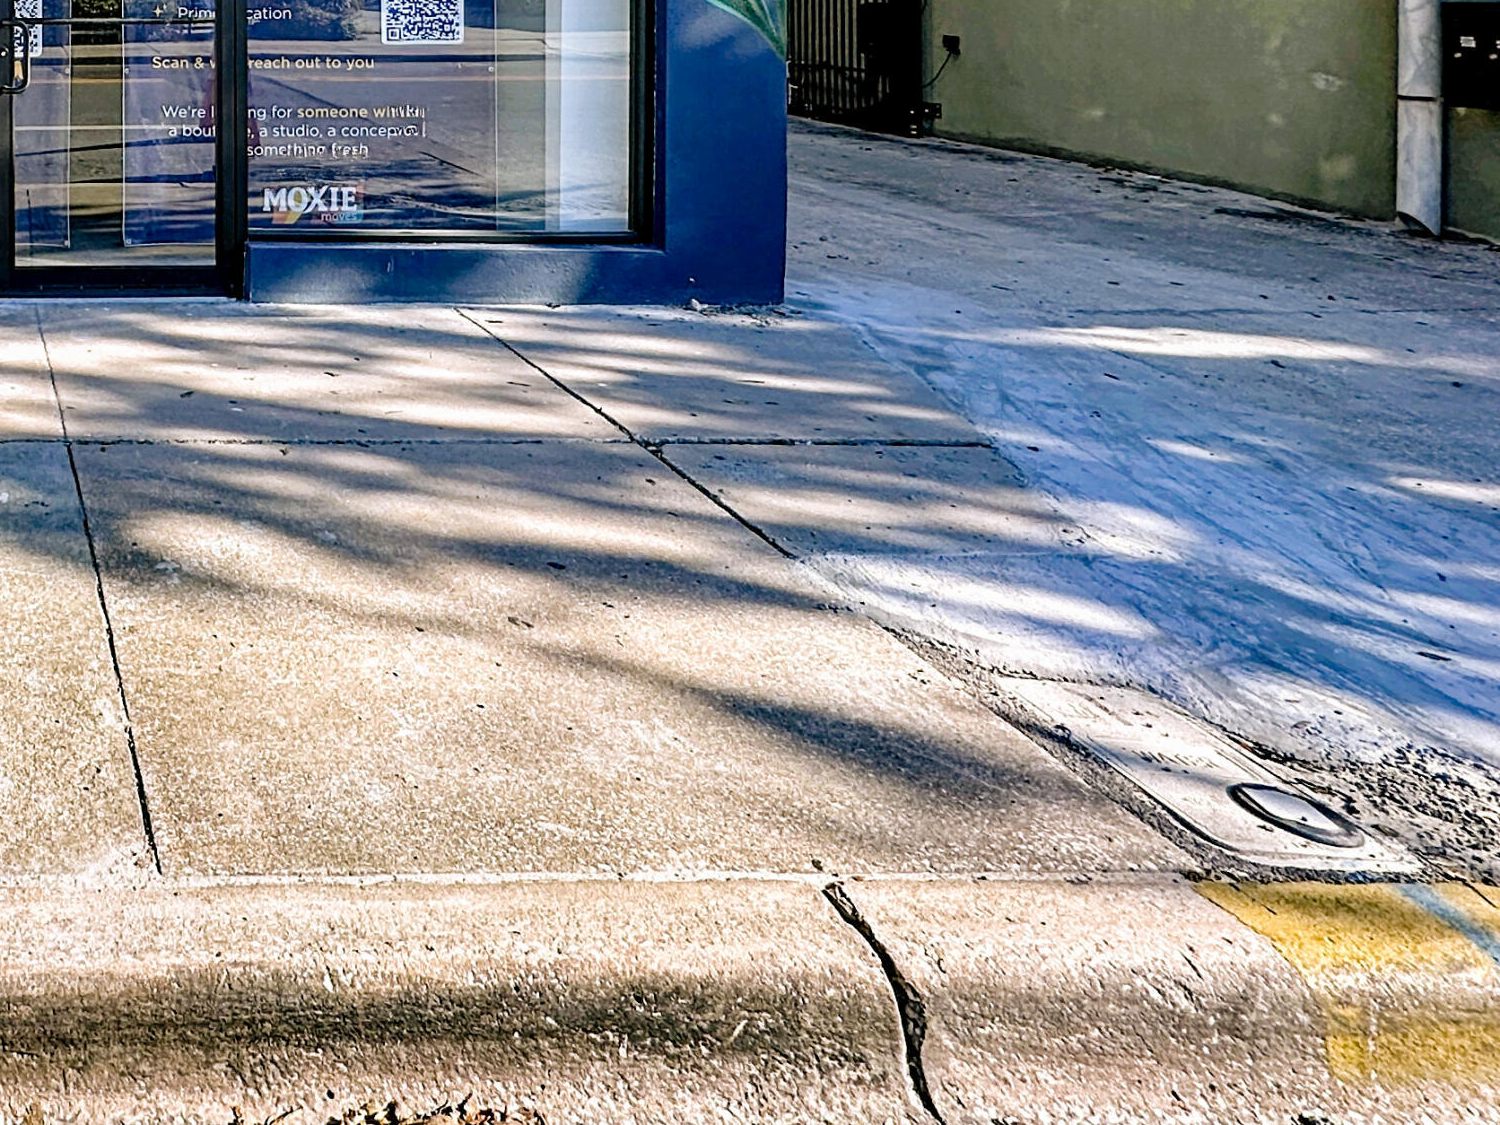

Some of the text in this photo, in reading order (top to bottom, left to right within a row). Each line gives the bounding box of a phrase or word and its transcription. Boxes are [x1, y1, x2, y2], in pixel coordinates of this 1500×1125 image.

[152, 57, 189, 69] Scan
[194, 56, 205, 69] &
[295, 57, 321, 69] out
[326, 57, 342, 69] to
[346, 59, 375, 71] you
[162, 106, 206, 118] We're
[272, 105, 292, 118] for
[297, 107, 367, 118] someone
[168, 128, 177, 137] a
[260, 128, 268, 137] a
[273, 124, 323, 139] studio,
[328, 128, 336, 137] a
[263, 185, 357, 213] MOXIE
